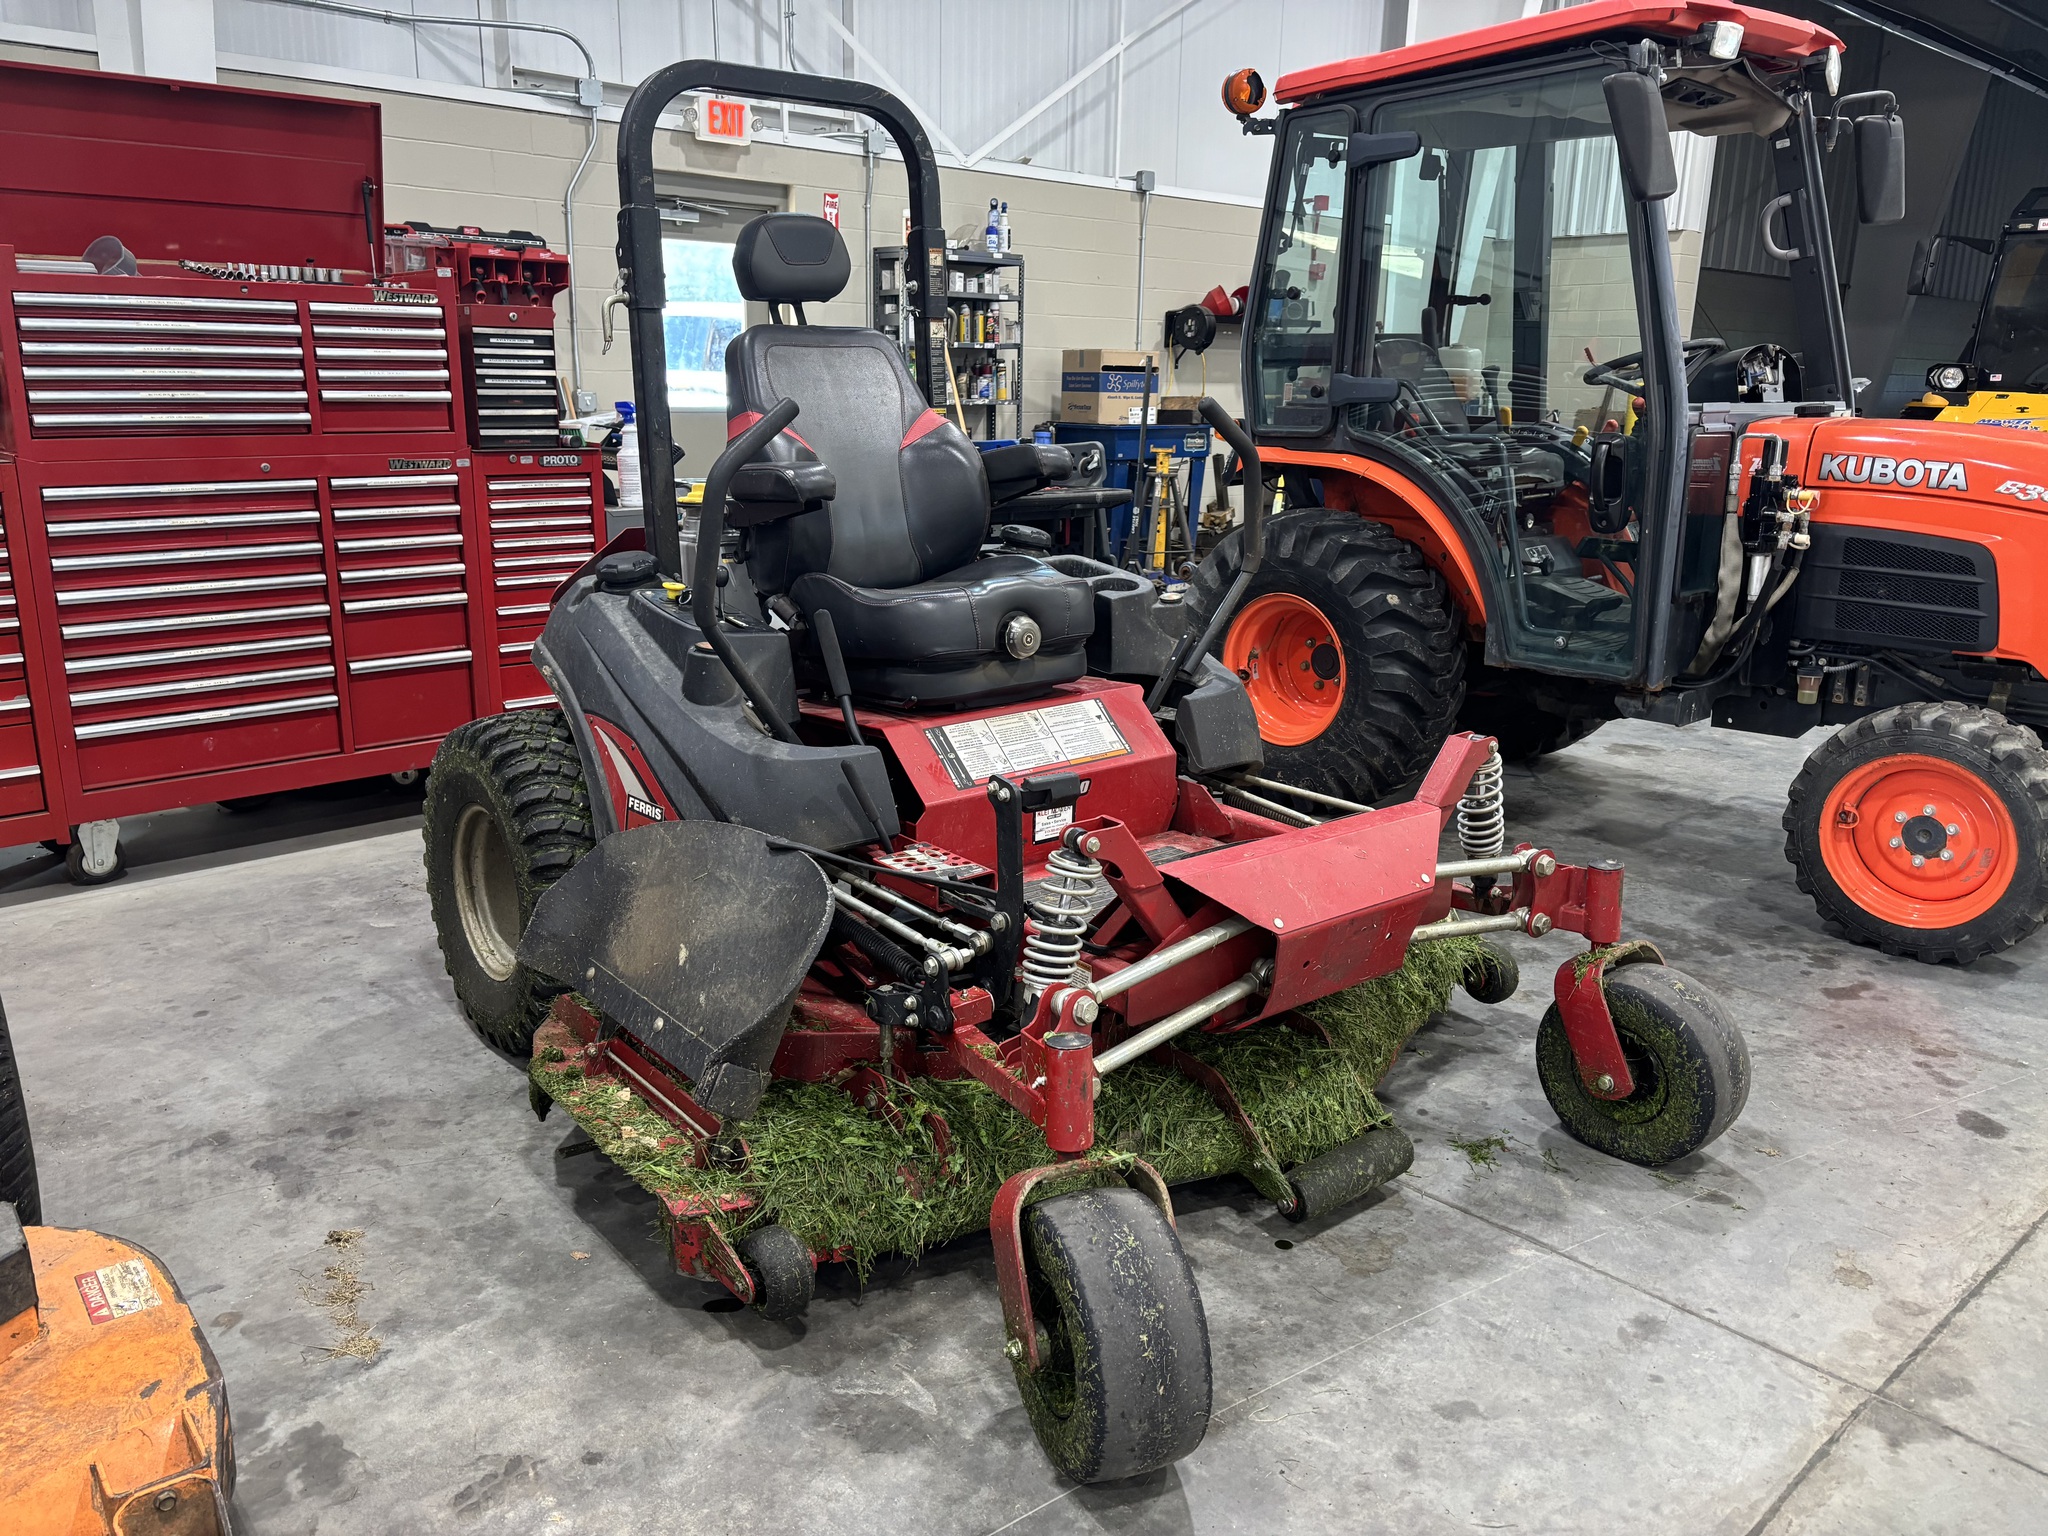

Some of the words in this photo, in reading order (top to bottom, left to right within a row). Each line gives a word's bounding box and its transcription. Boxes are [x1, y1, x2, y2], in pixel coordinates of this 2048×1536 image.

[707, 99, 745, 138] EXIT
[825, 199, 838, 210] FIRE
[373, 289, 439, 304] WESTWARD
[1975, 418, 2032, 426] MOWER
[388, 458, 452, 471] WESTWARD
[543, 454, 578, 465] PROTO
[1818, 453, 1968, 491] KUBOTA
[628, 796, 662, 821] FERRIS
[81, 1275, 106, 1308] DANGER
